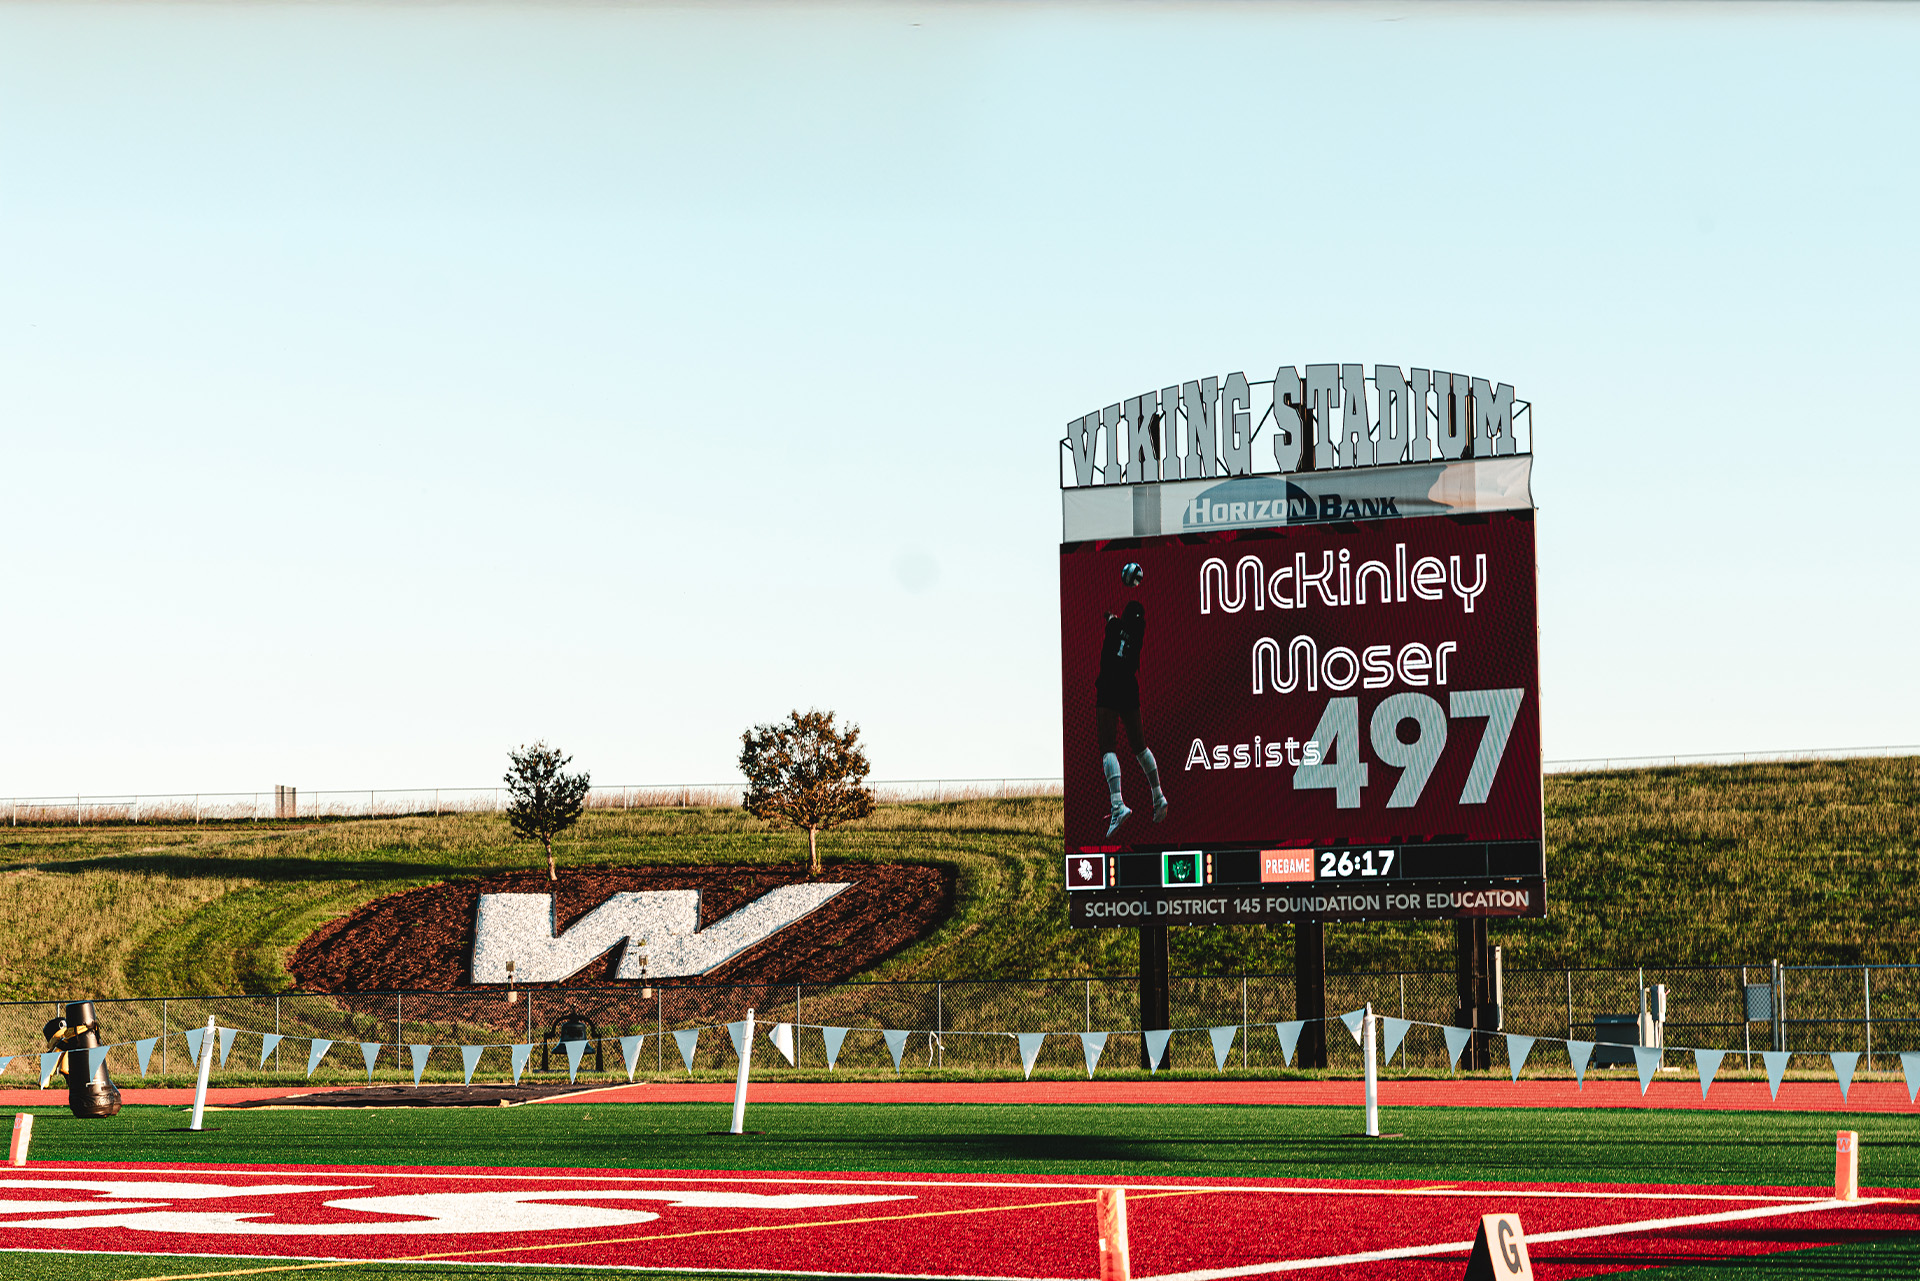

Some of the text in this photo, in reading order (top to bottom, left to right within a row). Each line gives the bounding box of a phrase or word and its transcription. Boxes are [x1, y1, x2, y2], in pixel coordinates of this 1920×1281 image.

[1067, 363, 1516, 487] VIKING STADIUM
[1199, 543, 1488, 615] McKinley
[1252, 635, 1457, 695] Moser
[1185, 735, 1321, 770] Assists
[1292, 687, 1525, 810] 497
[1265, 857, 1311, 876] PREGAME
[1320, 850, 1395, 877] 26:17
[1084, 890, 1530, 917] SCHOOL DISTRICT 145 FOUNDATION FOR EDUCATION
[471, 881, 858, 984] W
[1498, 1219, 1523, 1274] G
